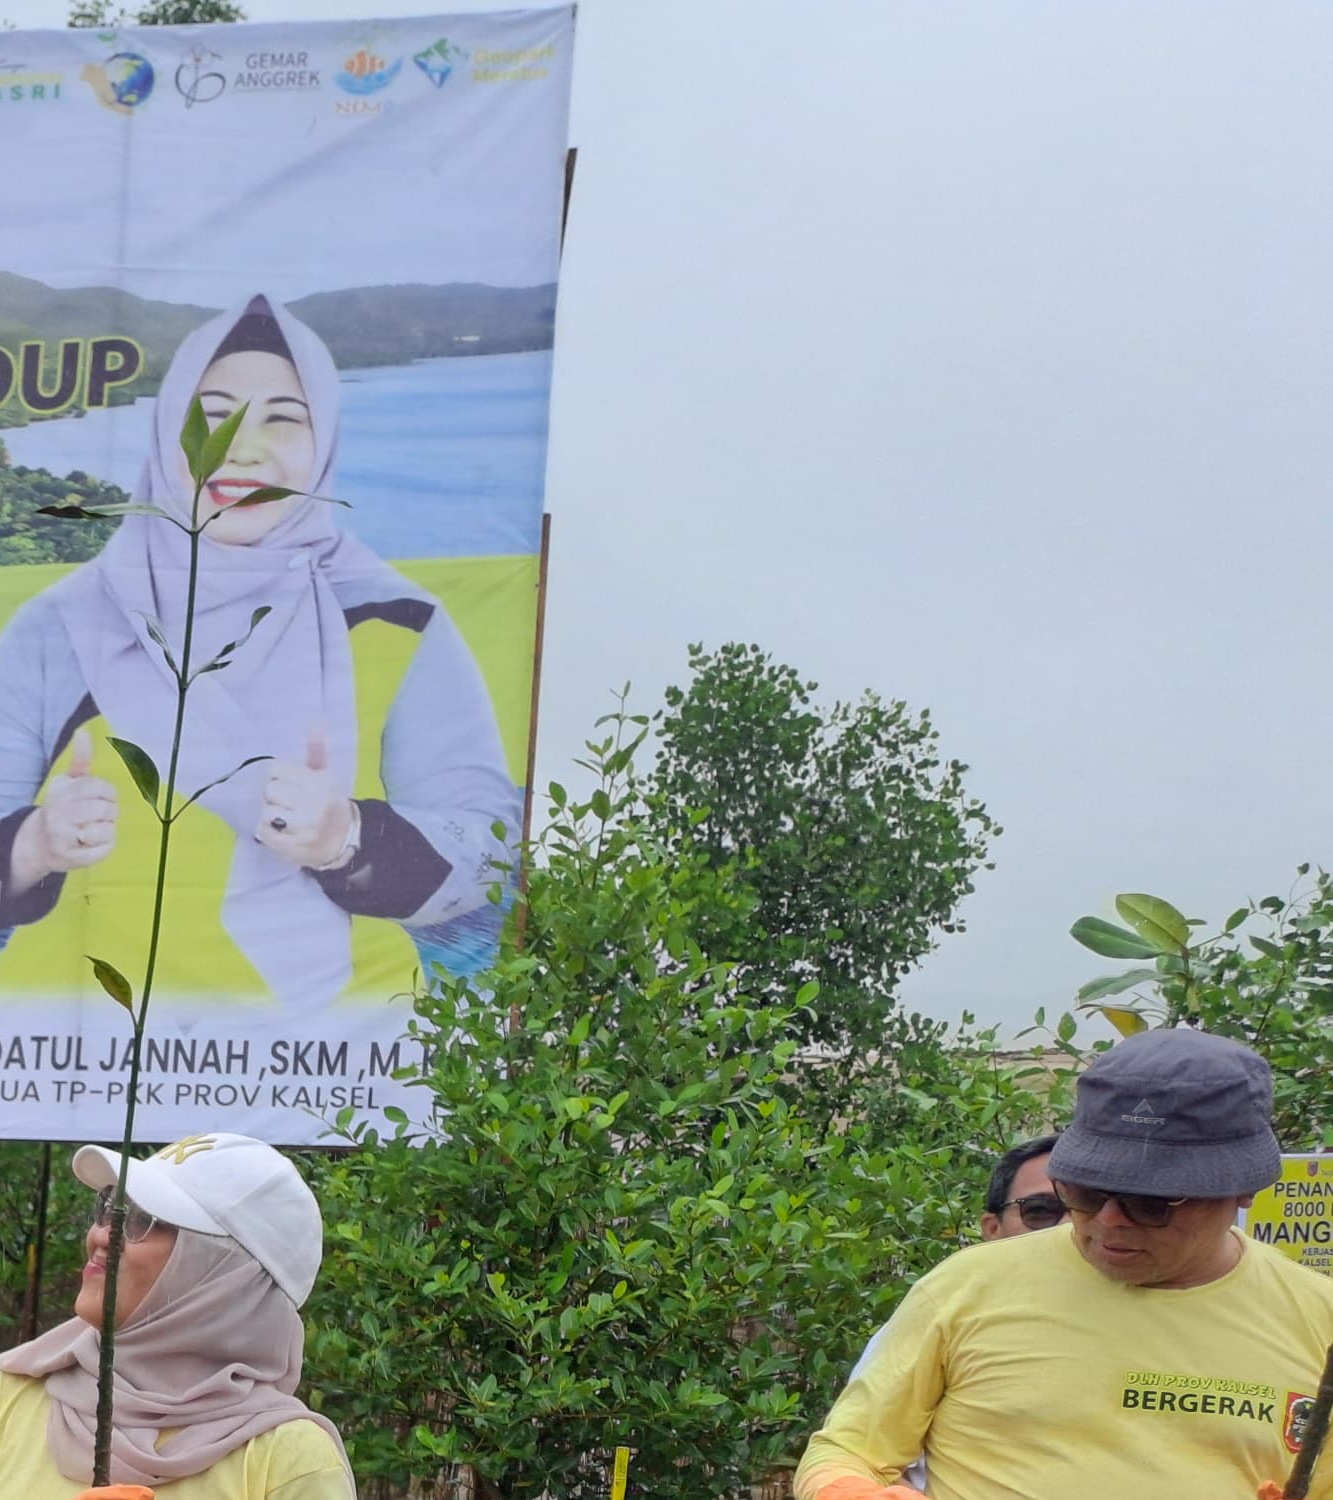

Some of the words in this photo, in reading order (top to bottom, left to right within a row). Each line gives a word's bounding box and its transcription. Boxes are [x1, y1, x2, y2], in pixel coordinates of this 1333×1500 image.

[245, 52, 308, 69] GEMAR
[235, 69, 321, 88] ANGGREK
[99, 1037, 249, 1074] JANNAH
[175, 1083, 261, 1107] PROV
[270, 1084, 381, 1110] KALSEL
[1284, 1201, 1326, 1218] 8000
[1125, 1371, 1160, 1386] DLH
[1164, 1374, 1213, 1390] PROV
[1214, 1378, 1278, 1399] KALSEL
[1122, 1389, 1276, 1424] BERGERAK
